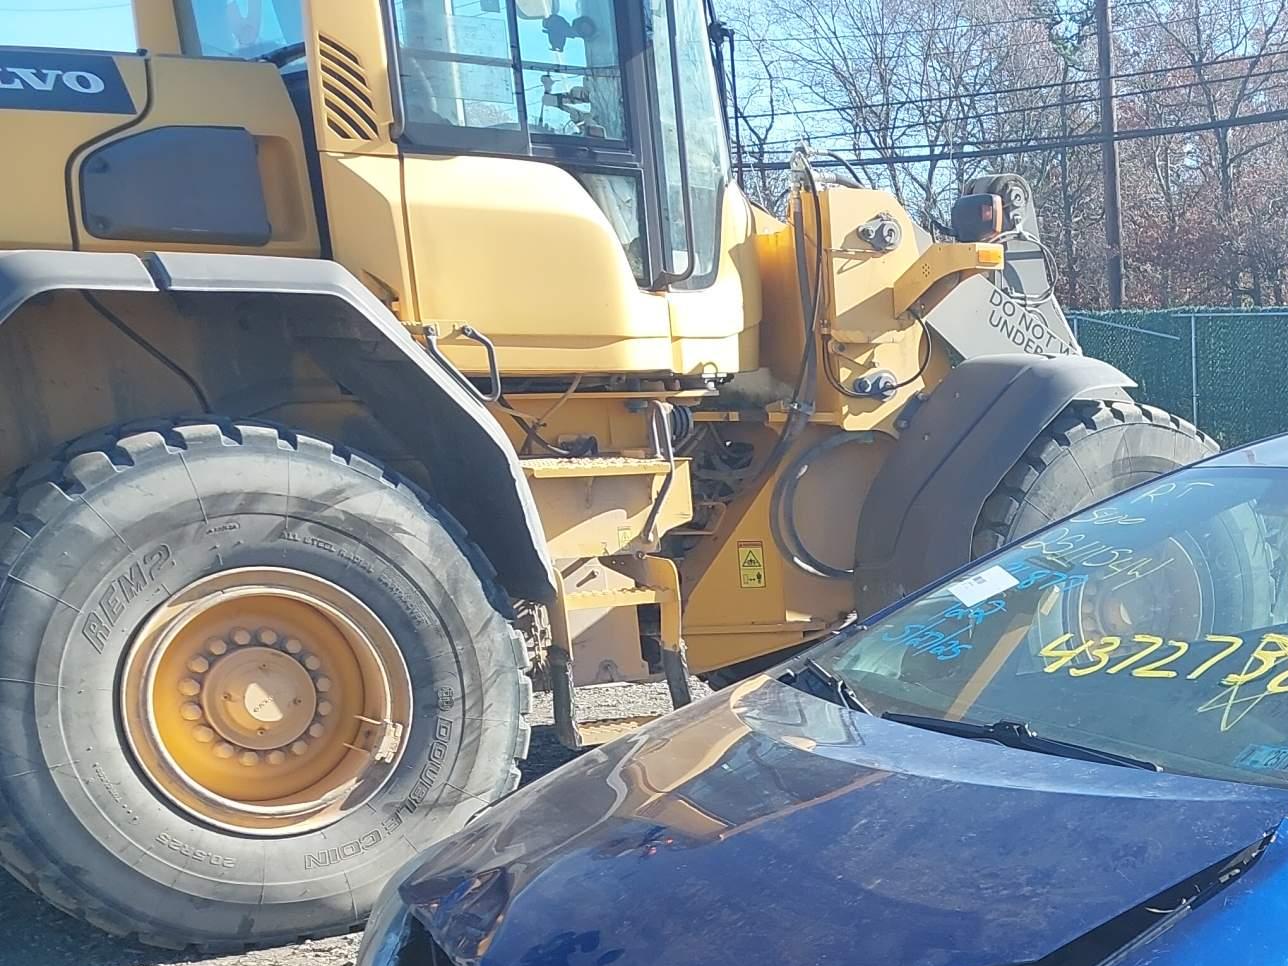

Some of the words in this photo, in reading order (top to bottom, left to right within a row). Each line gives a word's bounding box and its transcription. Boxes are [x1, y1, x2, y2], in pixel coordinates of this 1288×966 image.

[989, 289, 1016, 317] DO
[1018, 312, 1056, 347] NOT
[381, 715, 452, 834] DOUBLE
[304, 829, 382, 870] COIN
